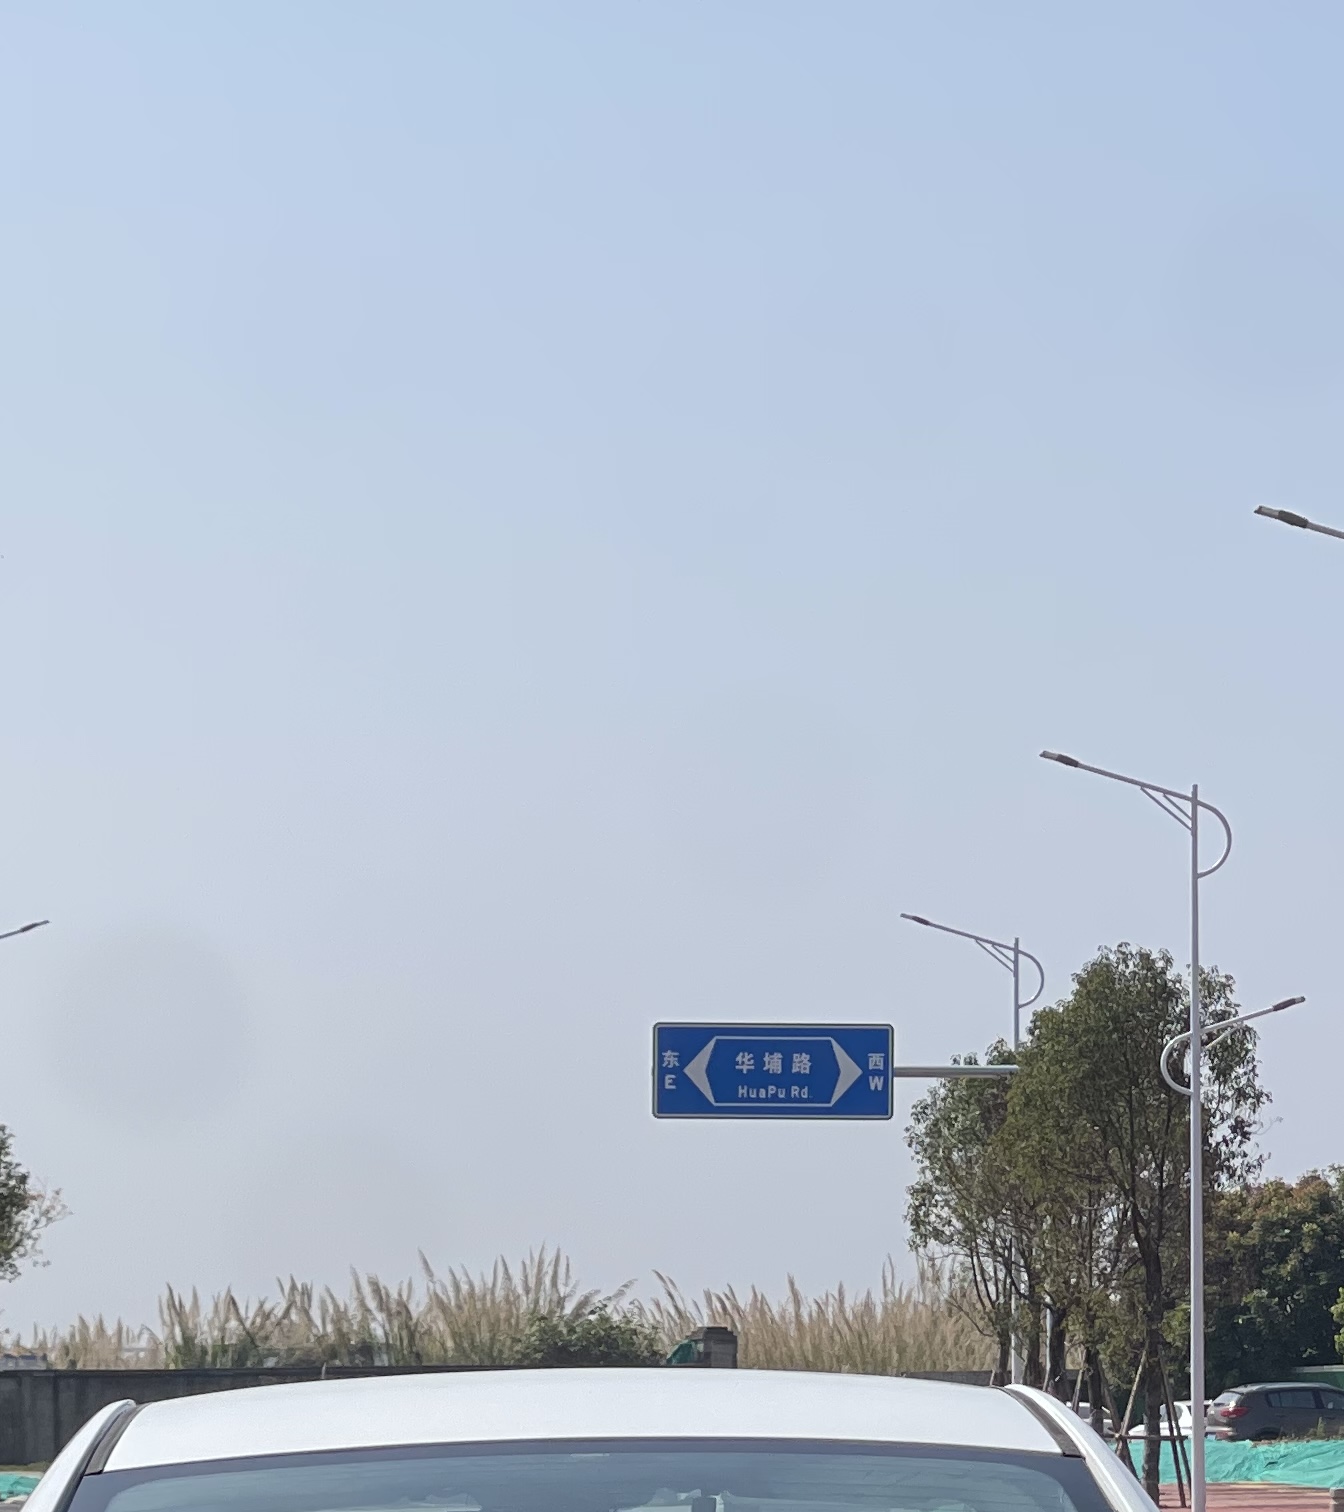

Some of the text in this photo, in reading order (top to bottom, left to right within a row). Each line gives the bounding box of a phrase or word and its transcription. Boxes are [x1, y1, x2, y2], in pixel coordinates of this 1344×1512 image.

[661, 1050, 680, 1069] 东
[735, 1051, 813, 1075] 华埔路
[867, 1052, 885, 1071] 西
[664, 1074, 677, 1090] E
[868, 1075, 885, 1091] W
[737, 1085, 786, 1099] HuaPu
